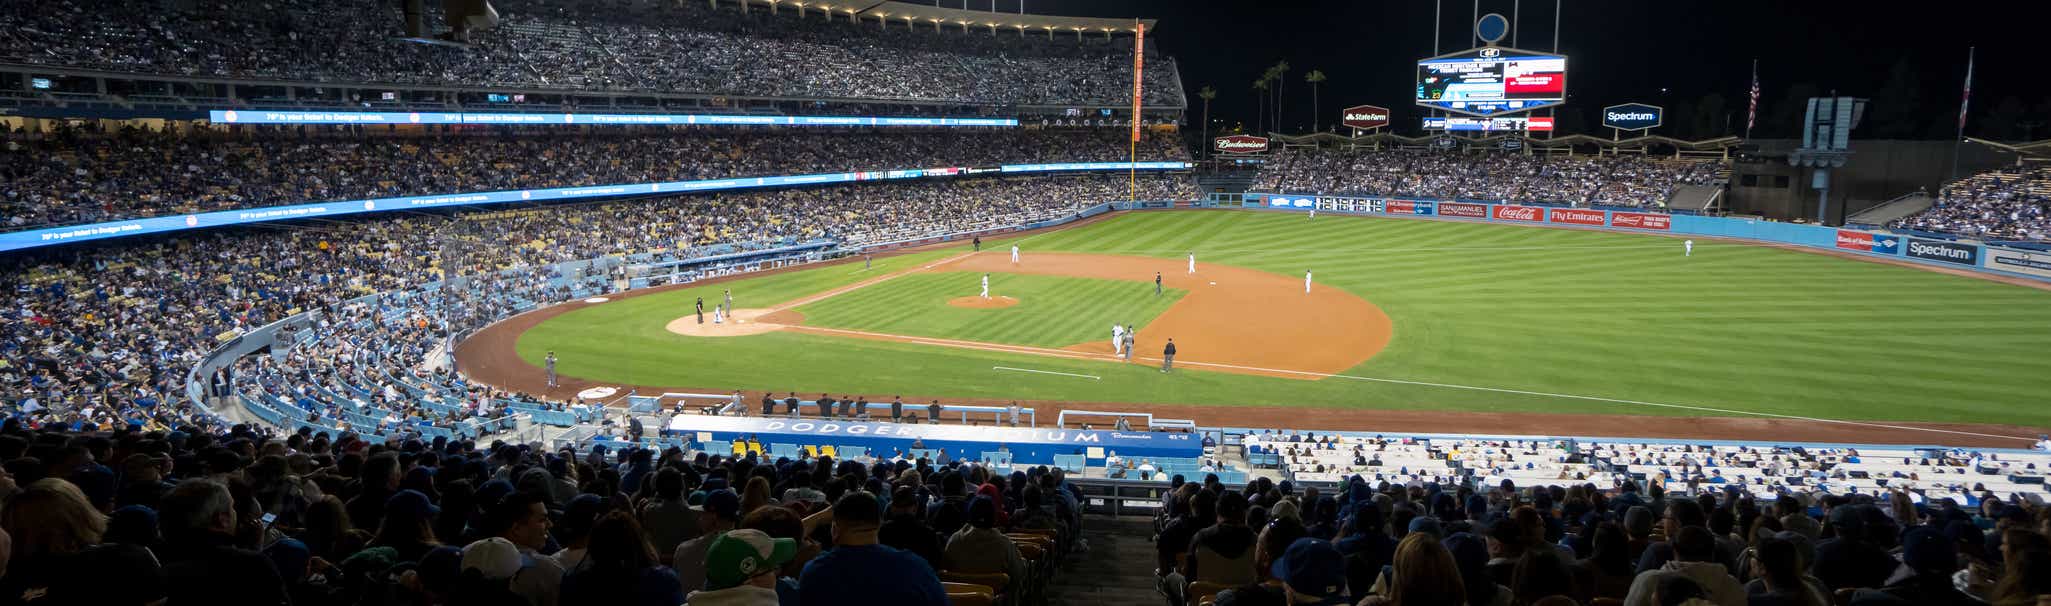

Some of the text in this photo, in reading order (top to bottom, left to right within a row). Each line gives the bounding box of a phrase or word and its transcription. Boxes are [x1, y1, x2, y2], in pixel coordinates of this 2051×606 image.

[1608, 112, 1653, 122] Spectrum
[1217, 139, 1265, 149] Budweiser
[1552, 212, 1604, 222] Fly Emirates
[1910, 242, 1969, 260] Spectrum
[766, 421, 913, 436] DODGER
